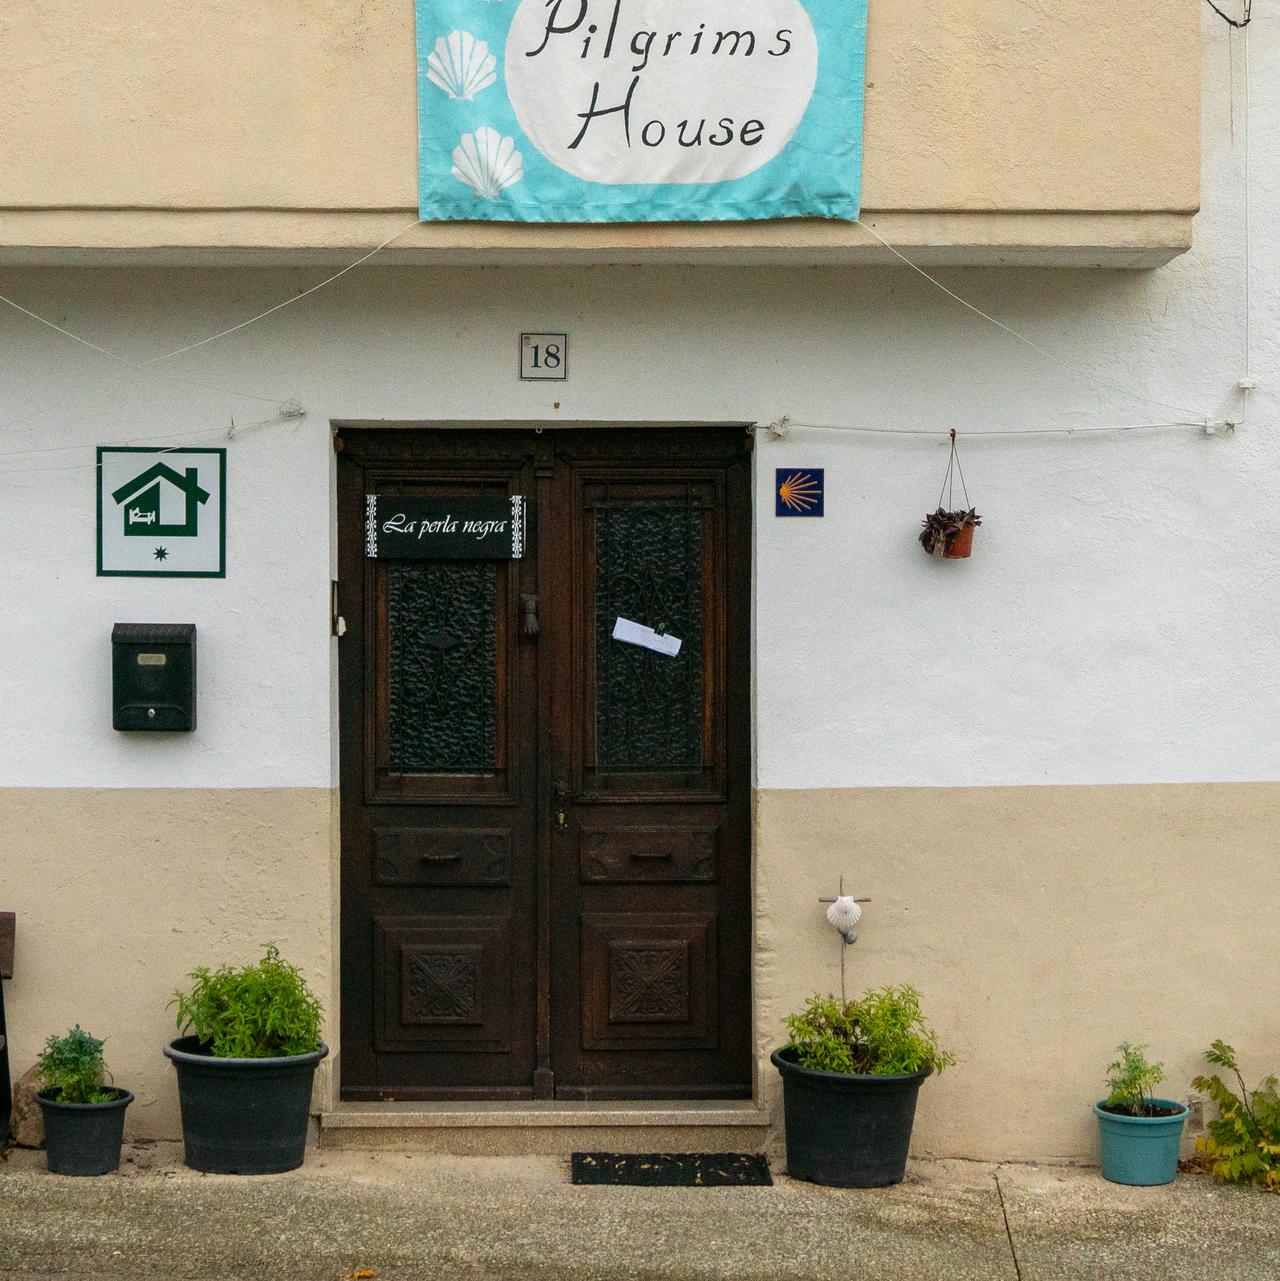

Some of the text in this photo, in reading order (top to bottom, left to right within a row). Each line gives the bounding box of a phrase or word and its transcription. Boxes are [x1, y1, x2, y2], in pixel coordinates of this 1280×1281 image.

[566, 75, 766, 150] House
[530, 343, 561, 368] 18
[382, 513, 508, 540] La perla negra
